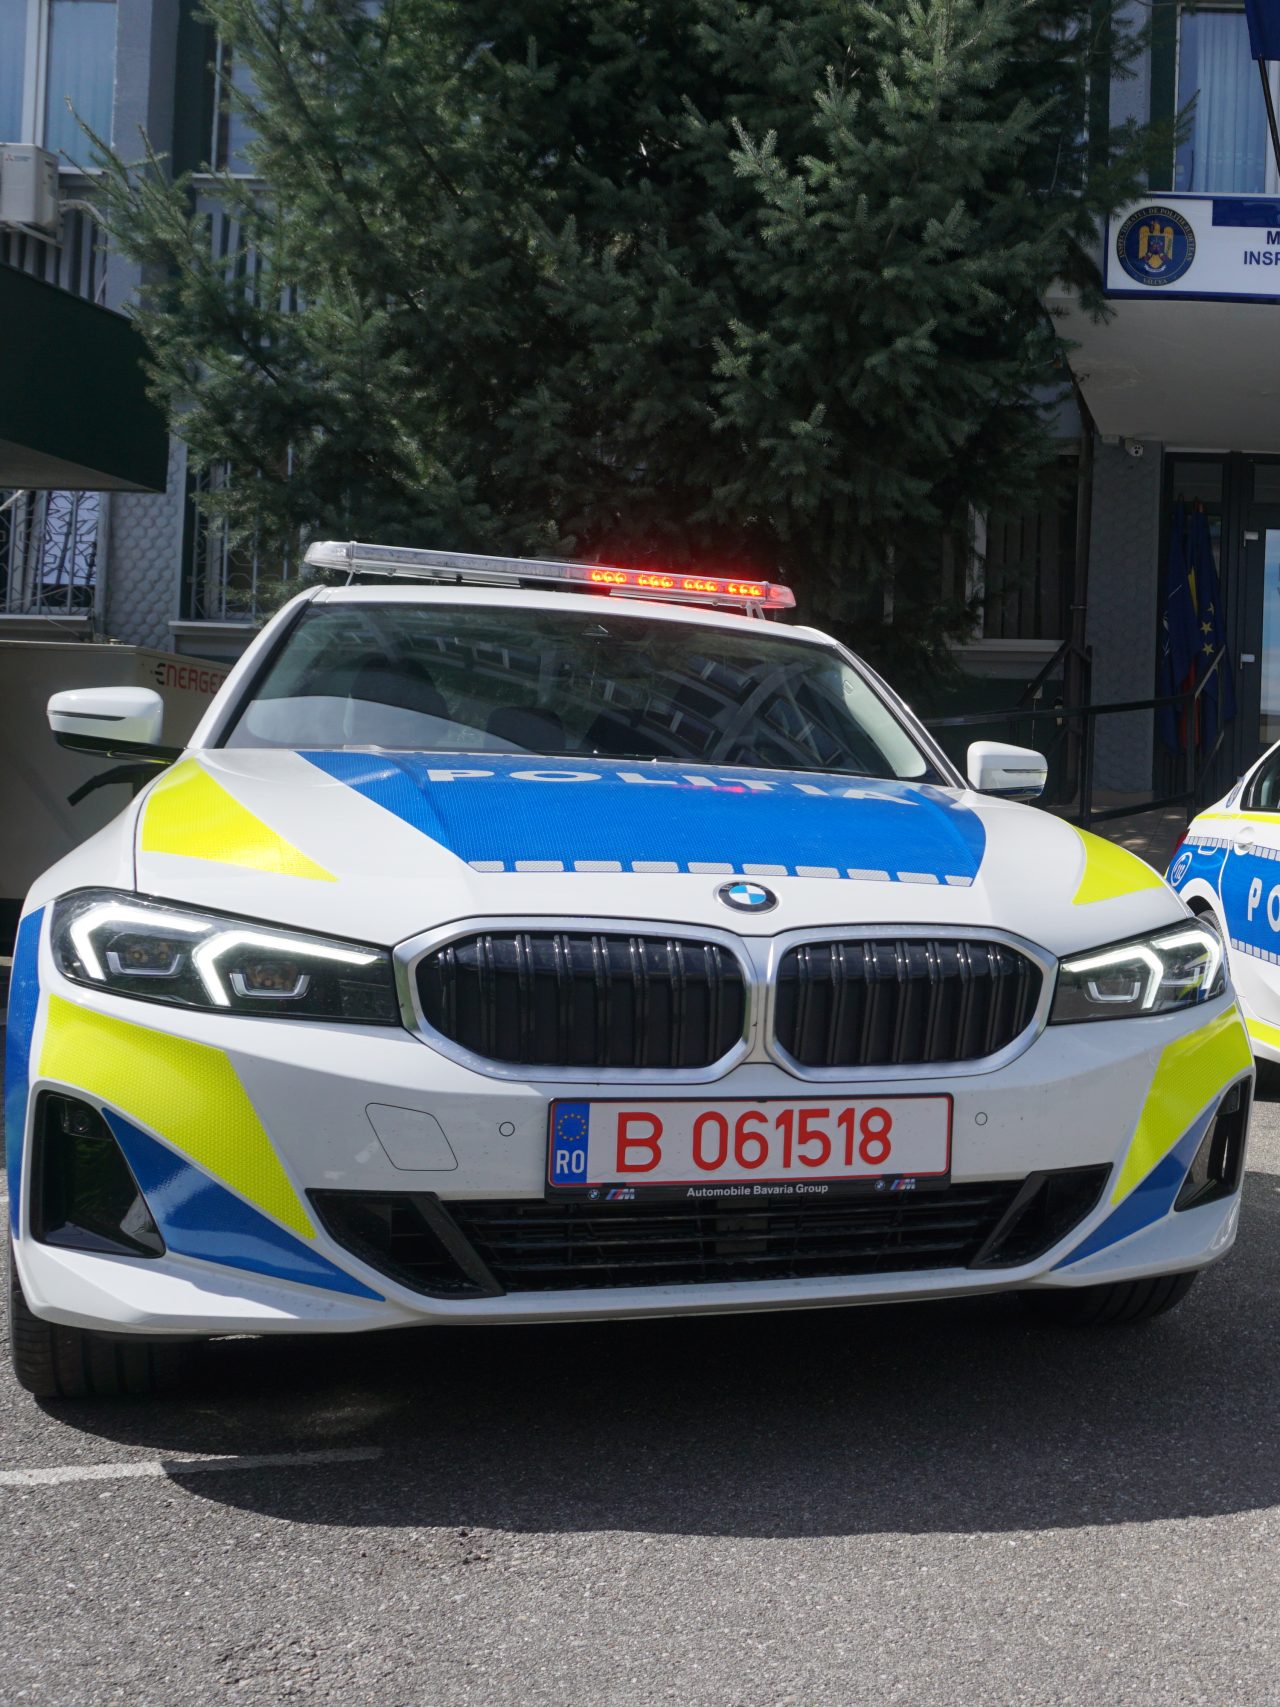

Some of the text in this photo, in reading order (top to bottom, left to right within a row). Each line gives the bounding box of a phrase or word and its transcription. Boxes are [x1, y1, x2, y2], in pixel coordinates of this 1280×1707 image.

[427, 769, 919, 806] POLITIA
[616, 1107, 893, 1173] B 061518
[556, 1149, 585, 1174] RO
[687, 1184, 829, 1197] Automobile Bavaria Group
